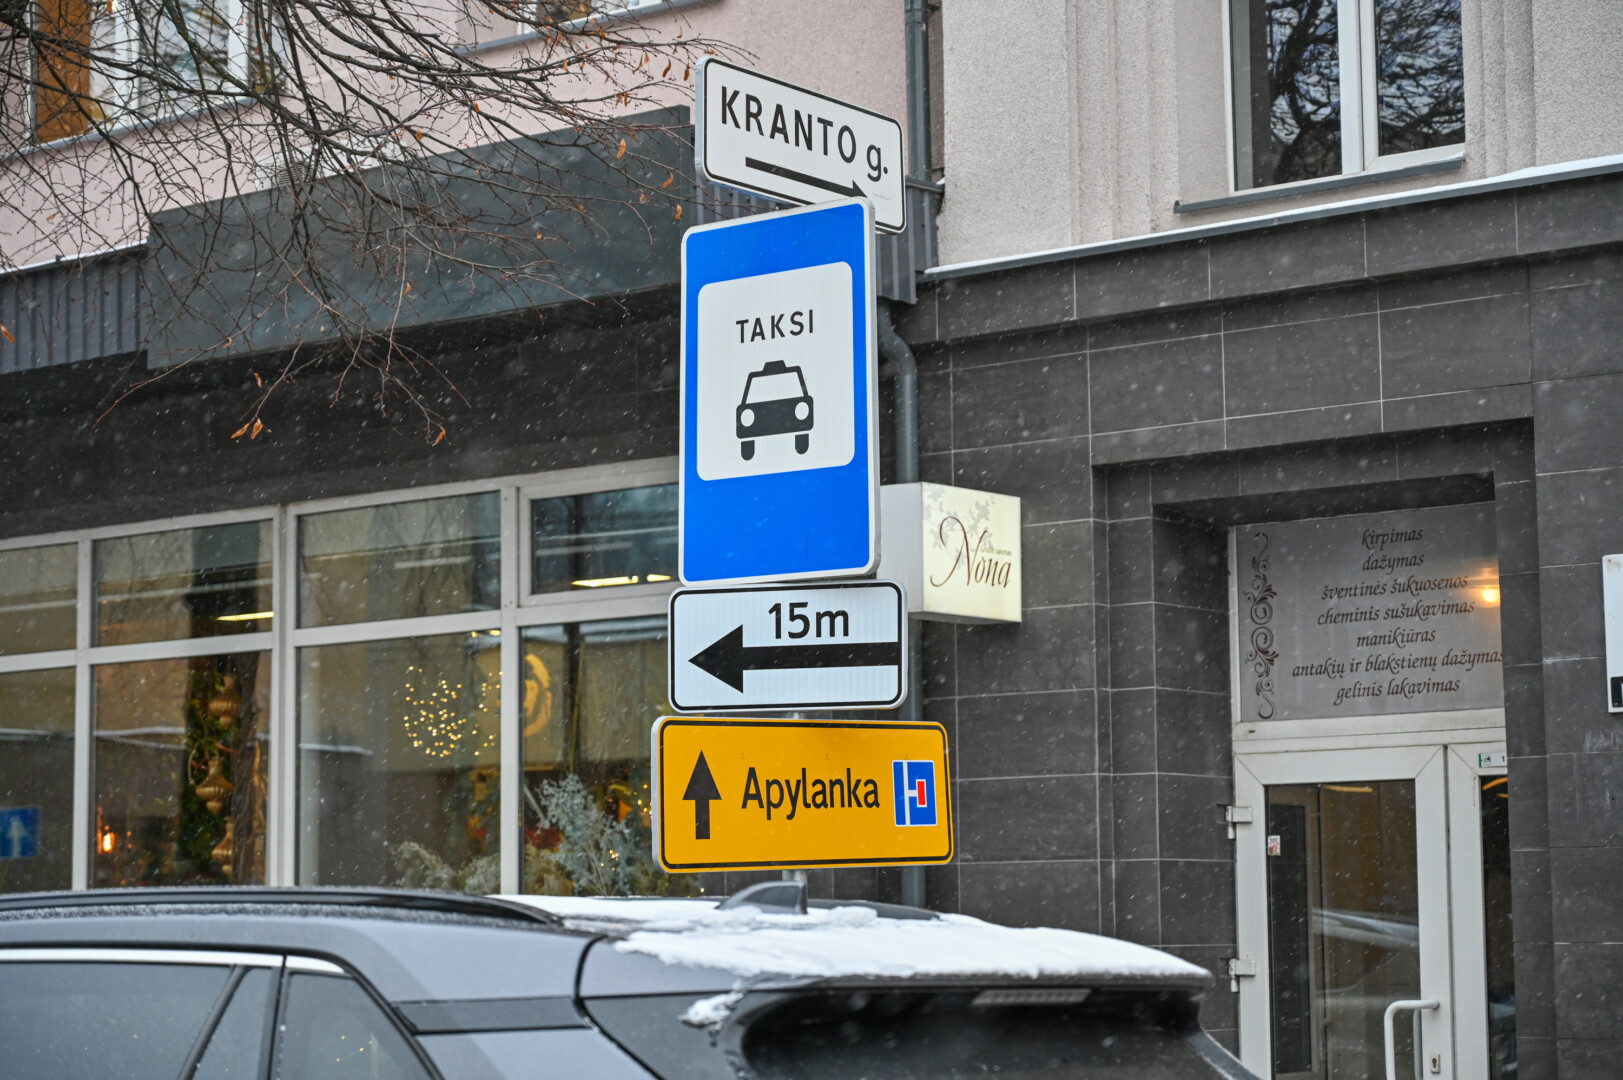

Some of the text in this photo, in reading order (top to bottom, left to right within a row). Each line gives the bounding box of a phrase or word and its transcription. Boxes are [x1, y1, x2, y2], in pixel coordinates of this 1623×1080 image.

[721, 85, 889, 182] KRANTO g.
[735, 309, 814, 344] TAKSI
[930, 516, 1012, 588] Nona
[1361, 528, 1424, 550] kirpimas
[1362, 553, 1425, 575] dažymas
[1321, 574, 1469, 601] šventinės šukuosenos
[768, 601, 850, 640] 15m
[1317, 600, 1476, 625] cheminis sušukavimas
[1356, 627, 1437, 649] manikiūras
[1292, 657, 1345, 680] antakių
[1350, 658, 1362, 673] ir
[1365, 653, 1438, 675] blakstienų
[1333, 676, 1460, 706] gelinis lakavimas
[741, 766, 881, 821] Apylanka
